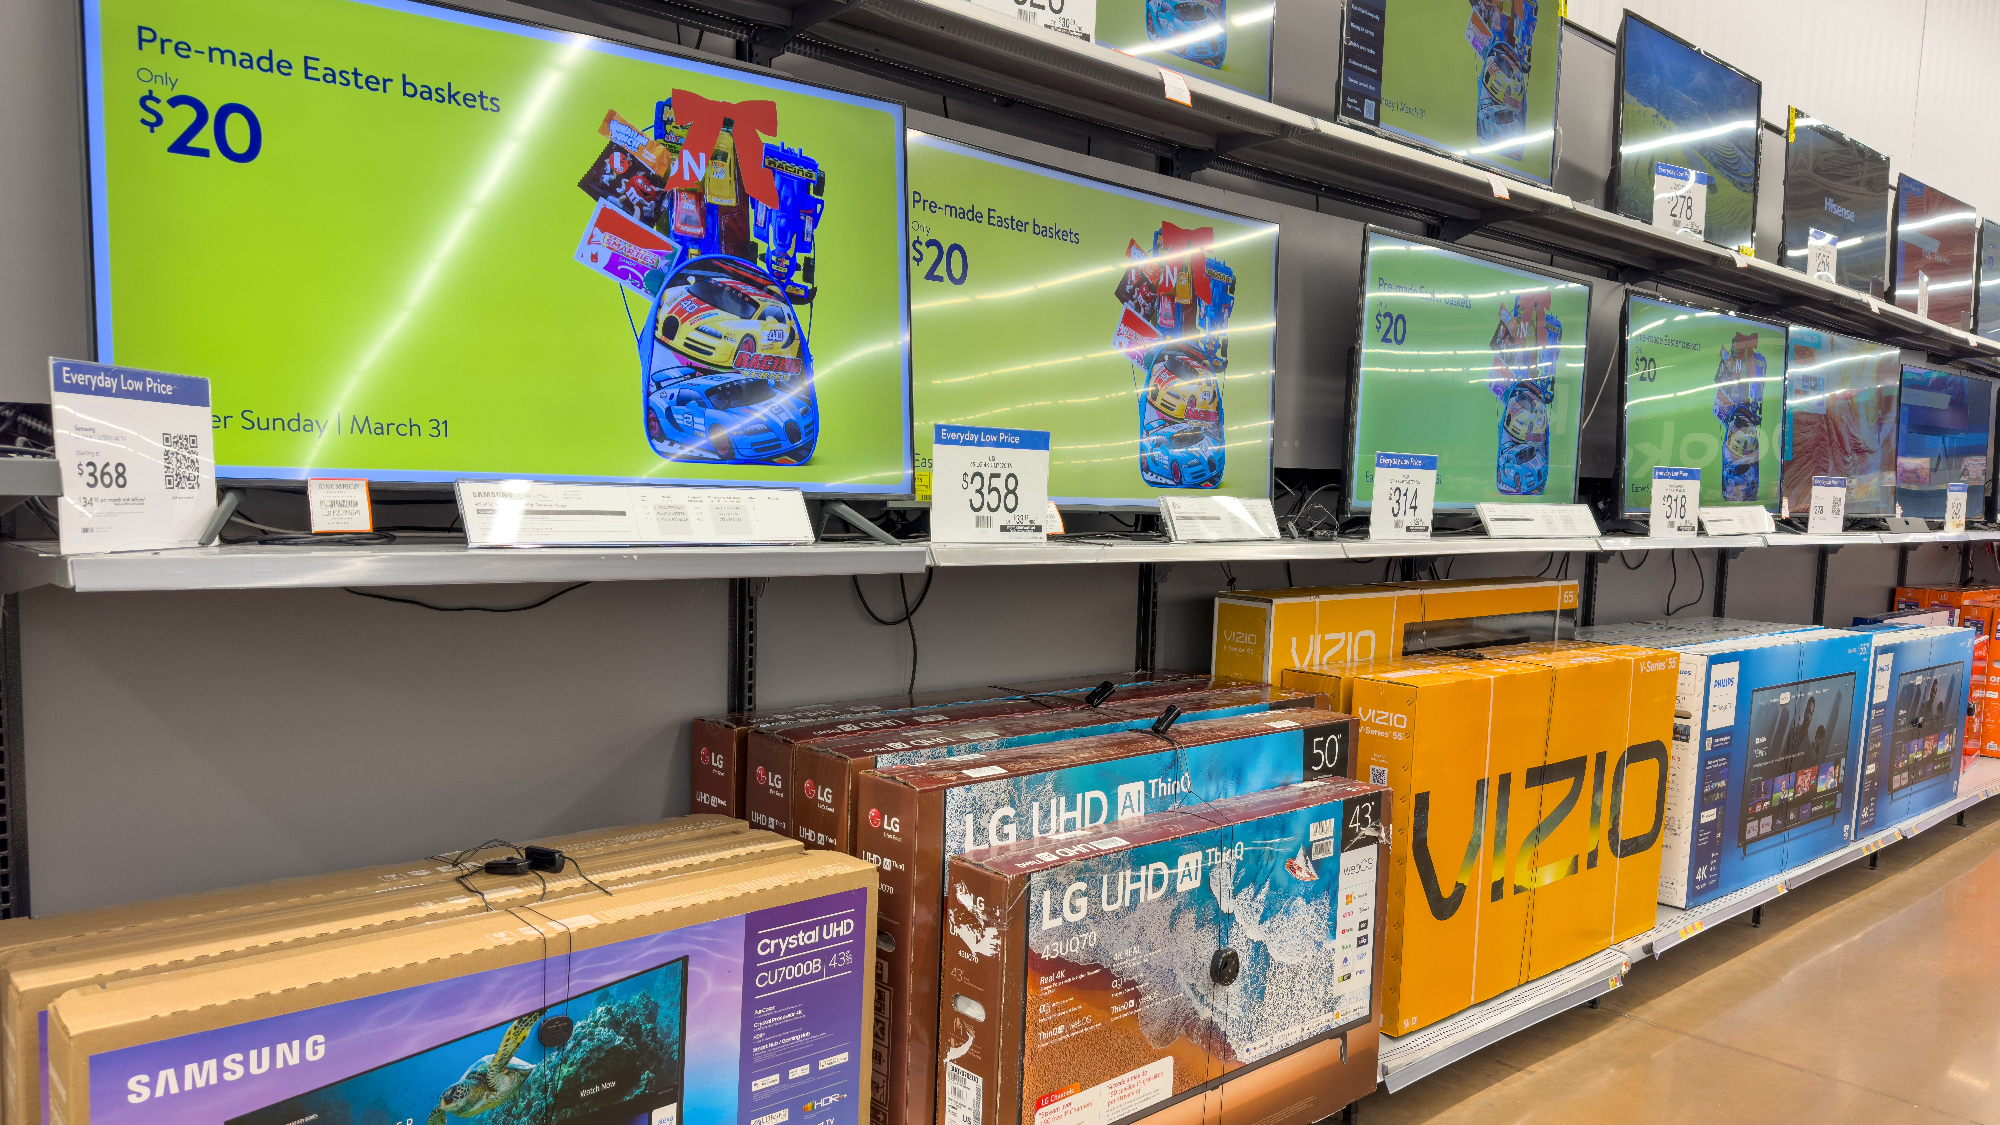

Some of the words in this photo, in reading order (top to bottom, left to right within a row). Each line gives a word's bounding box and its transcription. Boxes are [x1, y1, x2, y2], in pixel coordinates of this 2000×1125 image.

[136, 25, 293, 76] Pre-made
[303, 55, 393, 94] Easter
[402, 73, 501, 113] baskets
[136, 67, 179, 91] Only
[139, 89, 262, 164] $20
[912, 190, 983, 224] Pre-made
[988, 208, 1029, 233] Easter
[1033, 218, 1080, 245] baskets
[1824, 196, 1856, 222] Hisense
[911, 220, 931, 236] Only
[604, 237, 656, 267] SMARTIES
[912, 235, 968, 286] $20
[1375, 309, 1407, 346] $20
[732, 350, 802, 376] RACING
[1634, 355, 1657, 383] $20
[62, 366, 118, 393] Everyday
[120, 374, 143, 391] Low
[146, 377, 173, 395] Price
[742, 369, 791, 382] SERIES
[240, 409, 329, 440] Sunday
[350, 414, 422, 438] March
[428, 418, 449, 438] 31
[941, 429, 979, 444] Everyday
[980, 431, 998, 443] Low
[999, 433, 1020, 444] Price
[1410, 457, 1422, 466] Price
[77, 461, 127, 489] $368
[961, 471, 1019, 514] $358
[1223, 629, 1257, 645] VIZIO
[1291, 629, 1376, 668] VIZIO
[1713, 677, 1735, 689] PHILIPS
[1358, 706, 1408, 729] VIZIO
[711, 751, 724, 769] LG
[768, 771, 782, 789] LG
[817, 785, 833, 804] LG
[751, 810, 767, 826] UHD
[883, 814, 900, 833] LG
[964, 806, 1018, 855] LG
[1033, 789, 1109, 839] UHD
[1148, 771, 1192, 799] ThinQ
[799, 825, 816, 842] UHD
[1411, 739, 1669, 922] VIZIO
[862, 850, 882, 867] UHD
[1343, 856, 1374, 876] webOS
[1695, 864, 1708, 882] 4K
[1042, 881, 1089, 931] LG
[1102, 861, 1169, 912] UHD
[1205, 841, 1245, 868] ThinQ
[756, 925, 820, 957] Crystal
[822, 918, 855, 940] UHD
[1040, 930, 1097, 962] 43UQ70
[755, 957, 822, 989] CU7000B
[1039, 971, 1056, 986] Real
[1055, 968, 1067, 979] 4K
[752, 1043, 769, 1053] Smart
[768, 1040, 779, 1049] Hub
[781, 1034, 801, 1045] Gaming
[800, 1031, 811, 1039] Hub
[1037, 1027, 1058, 1041] ThinQ
[126, 1034, 327, 1105] SAMSUNG
[579, 1085, 600, 1098] Watch
[601, 1080, 617, 1091] Now
[1041, 1096, 1050, 1106] LG
[1050, 1087, 1075, 1103] Channels
